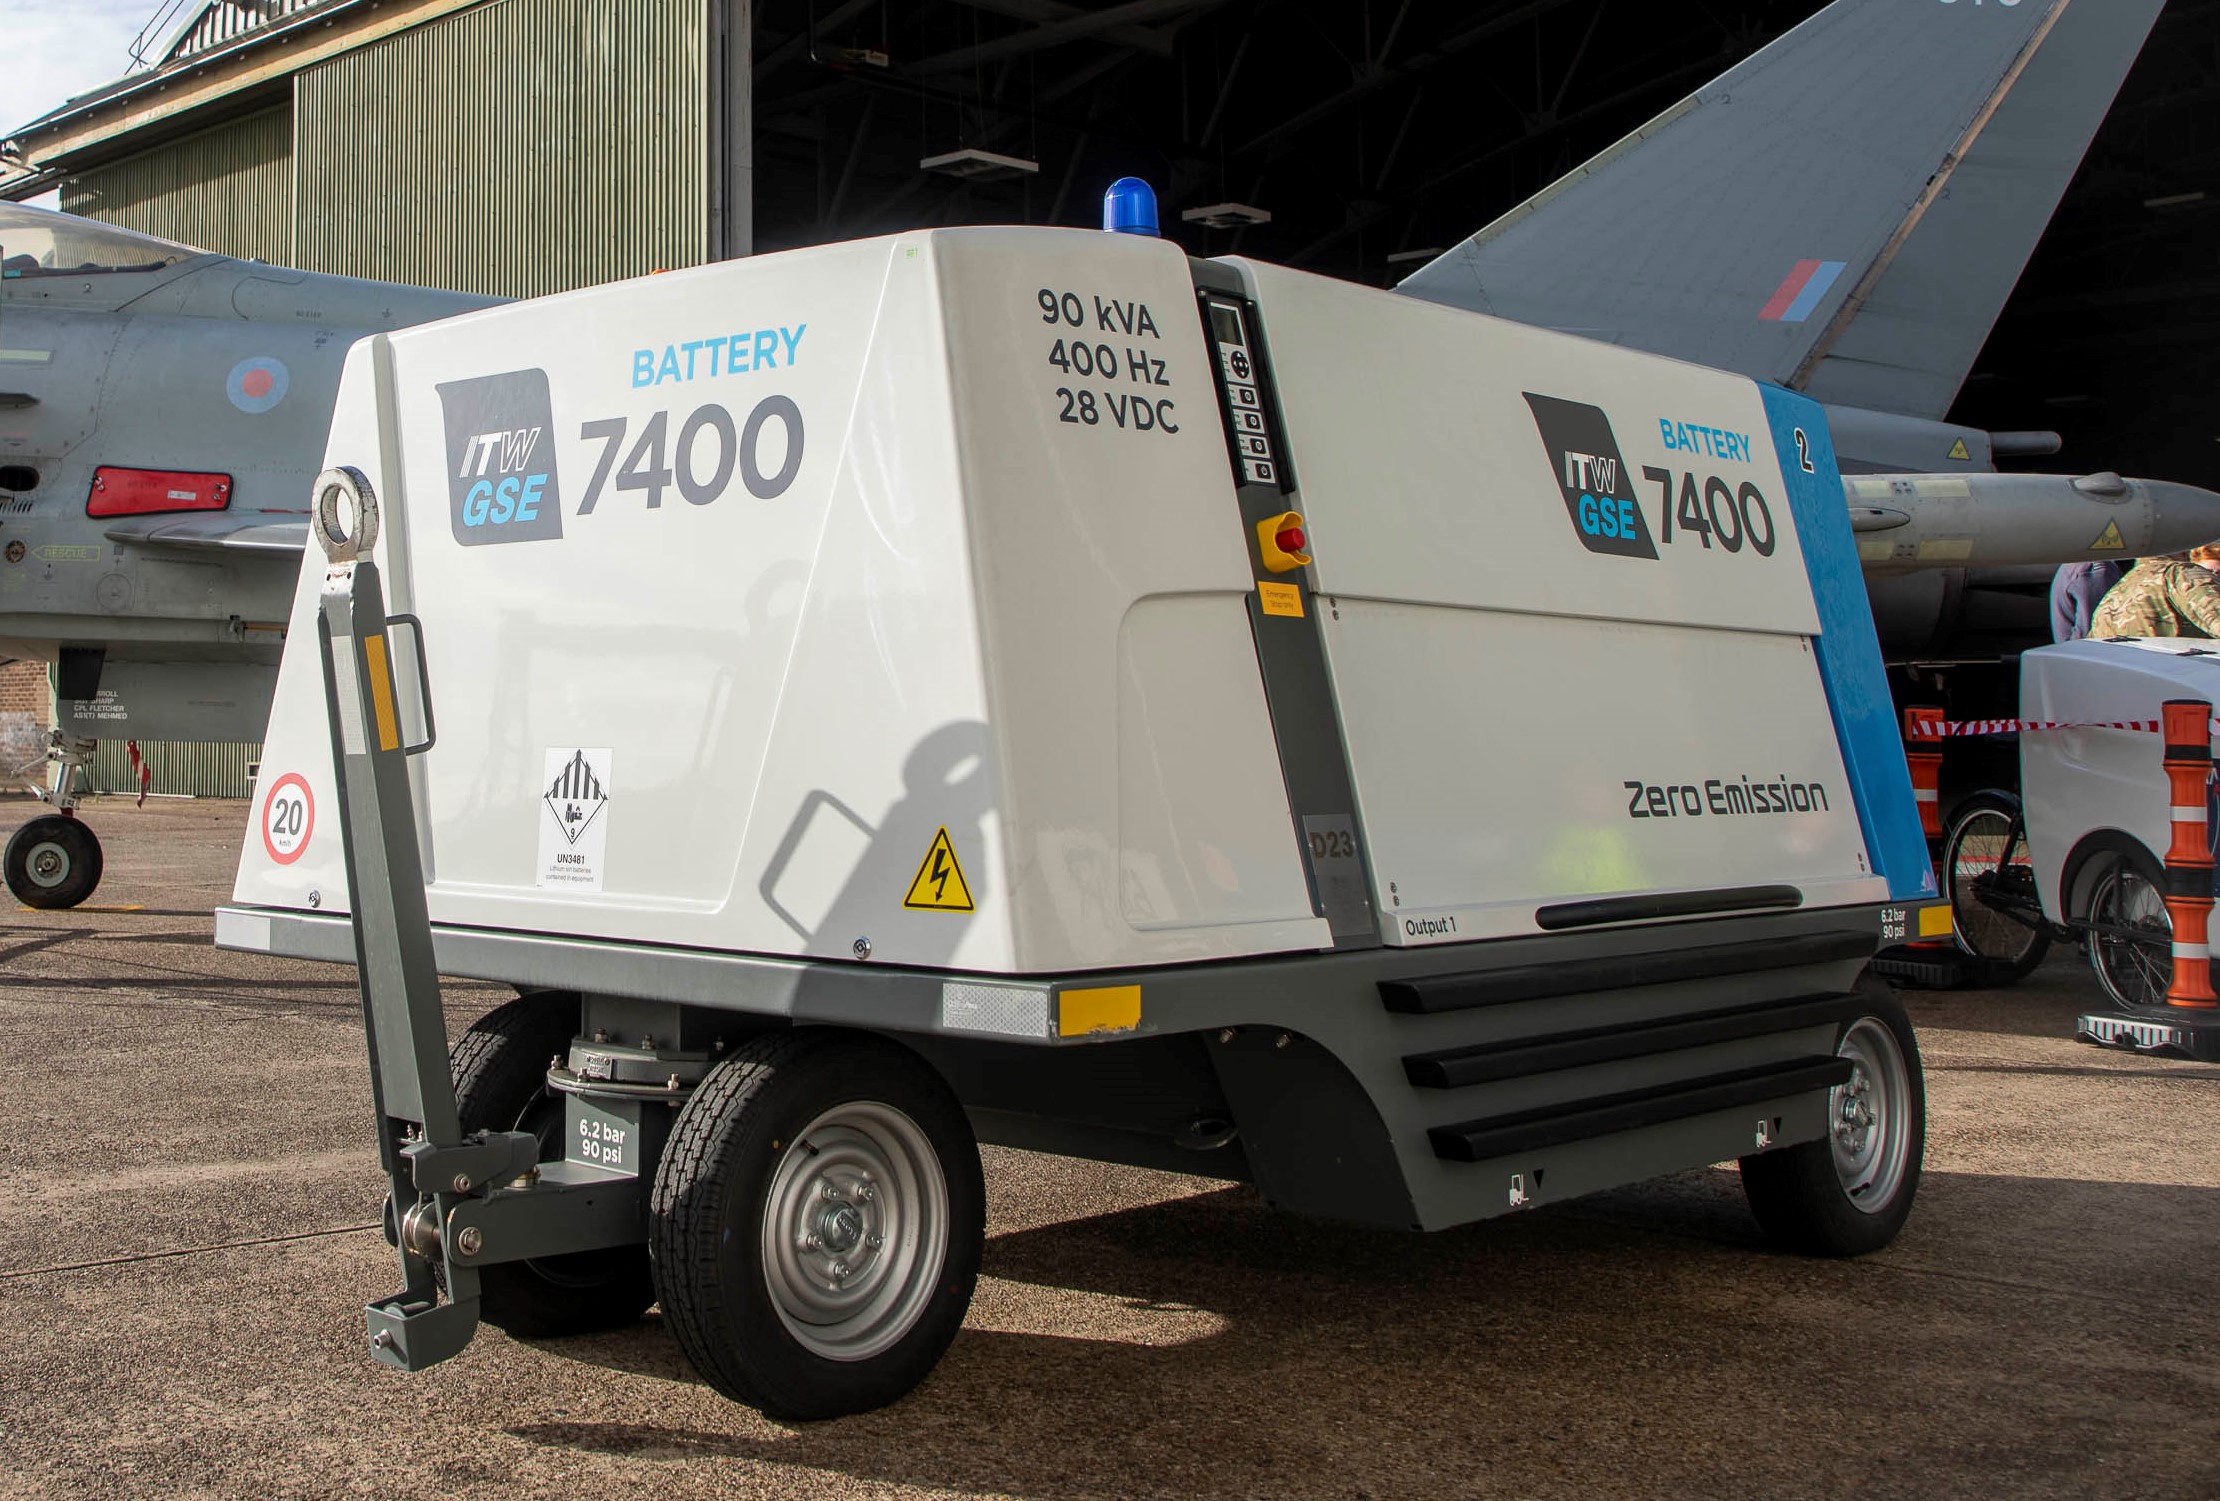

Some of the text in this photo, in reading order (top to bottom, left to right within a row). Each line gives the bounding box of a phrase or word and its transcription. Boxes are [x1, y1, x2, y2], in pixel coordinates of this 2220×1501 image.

[1037, 288, 1161, 340] 90 kVA
[631, 323, 807, 389] BATTERY
[1048, 338, 1170, 386] 400 Hz
[1055, 387, 1180, 434] 28 VDC
[459, 426, 542, 479] ITW
[576, 394, 805, 516] 7400
[1658, 417, 1751, 464] BATTERY
[1793, 427, 1815, 475] 2
[1564, 451, 1616, 495] ITW
[462, 472, 548, 528] GSE
[1578, 493, 1637, 541] GSE
[1641, 464, 1776, 558] 7400
[97, 712, 128, 720] MEHMED
[272, 798, 303, 836] 20
[1623, 774, 1829, 818] Zero Emission
[570, 827, 575, 838] 9
[1309, 830, 1355, 859] D23
[557, 853, 585, 865] UN3481
[1405, 916, 1457, 938] Output 1
[1881, 907, 1906, 923] 6.2 bar
[1883, 923, 1905, 939] 90 psi
[579, 1118, 626, 1144] 6.2 bar
[582, 1139, 622, 1164] 90 psi
